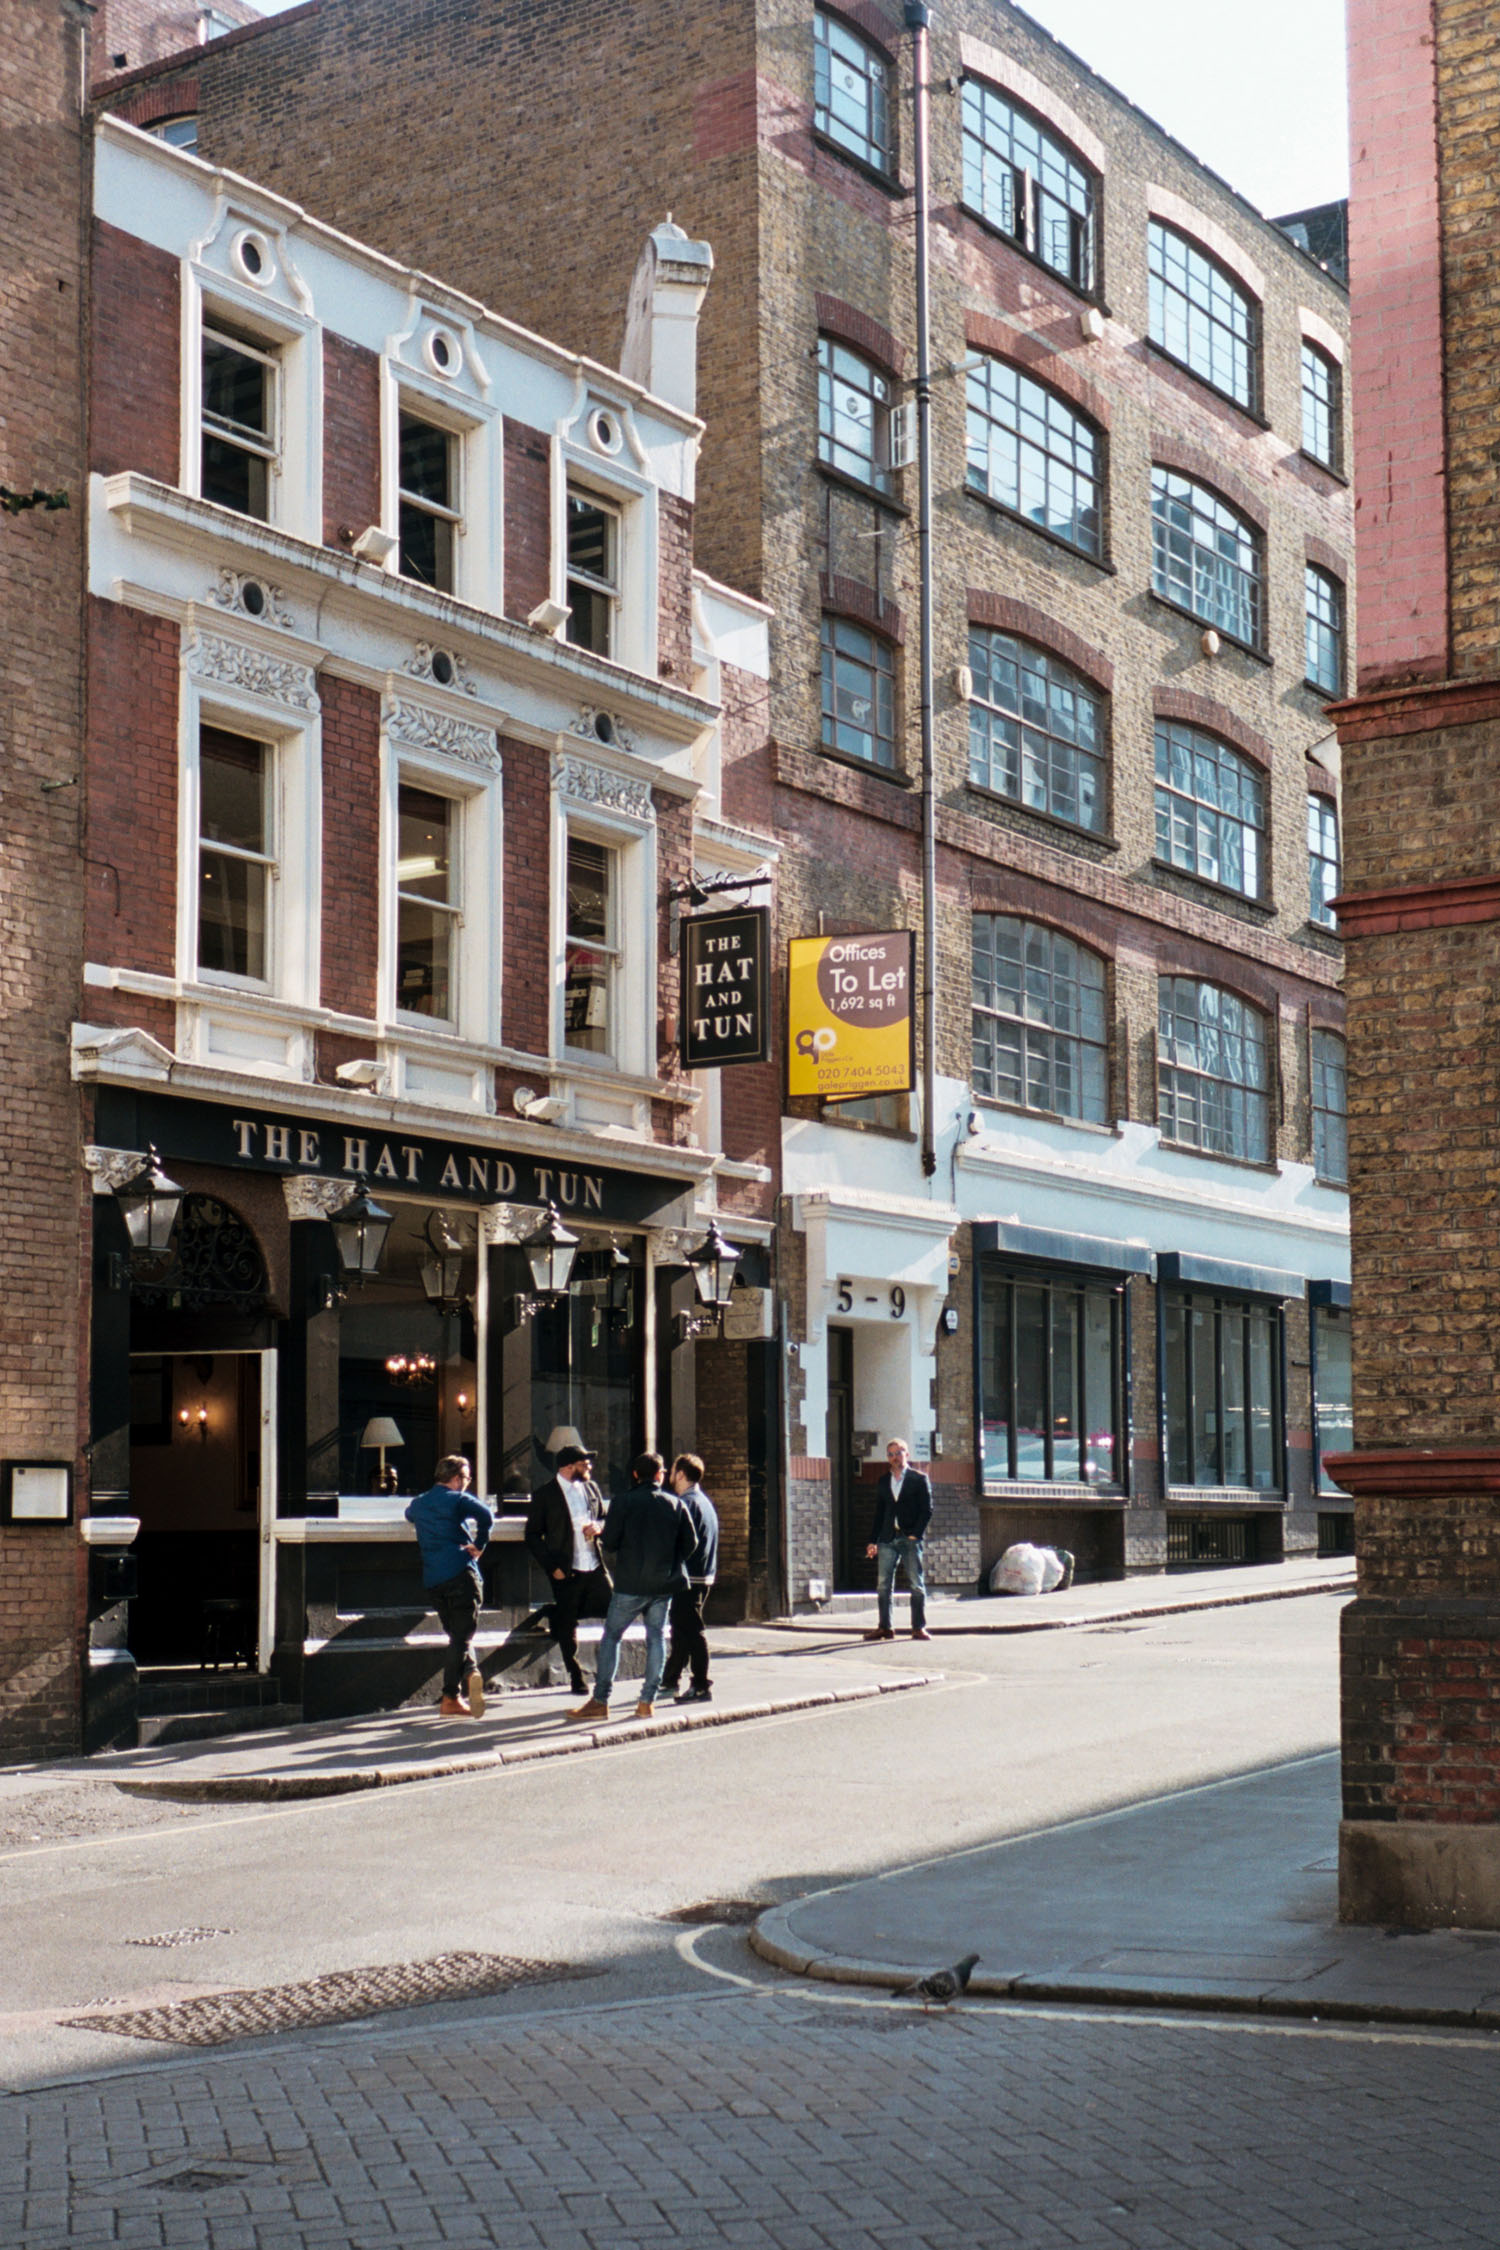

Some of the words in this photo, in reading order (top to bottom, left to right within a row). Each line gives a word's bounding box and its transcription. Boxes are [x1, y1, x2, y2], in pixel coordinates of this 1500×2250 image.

[705, 935, 741, 953] THE
[829, 943, 887, 963] Offices
[695, 957, 754, 986] HAT
[829, 968, 859, 994] To
[868, 965, 906, 991] Let
[705, 990, 743, 1009] AND
[829, 996, 865, 1012] 1,692
[868, 998, 884, 1011] sq
[886, 993, 896, 1007] ft
[694, 1013, 754, 1041] TUN
[817, 1068, 841, 1080] 020
[844, 1066, 873, 1078] 7404
[876, 1063, 906, 1076] 5043
[817, 1076, 905, 1092] galepriggen.couk
[232, 1119, 322, 1168] THE
[343, 1136, 424, 1183] HAT
[439, 1153, 517, 1196] AND
[533, 1167, 604, 1210] TUN
